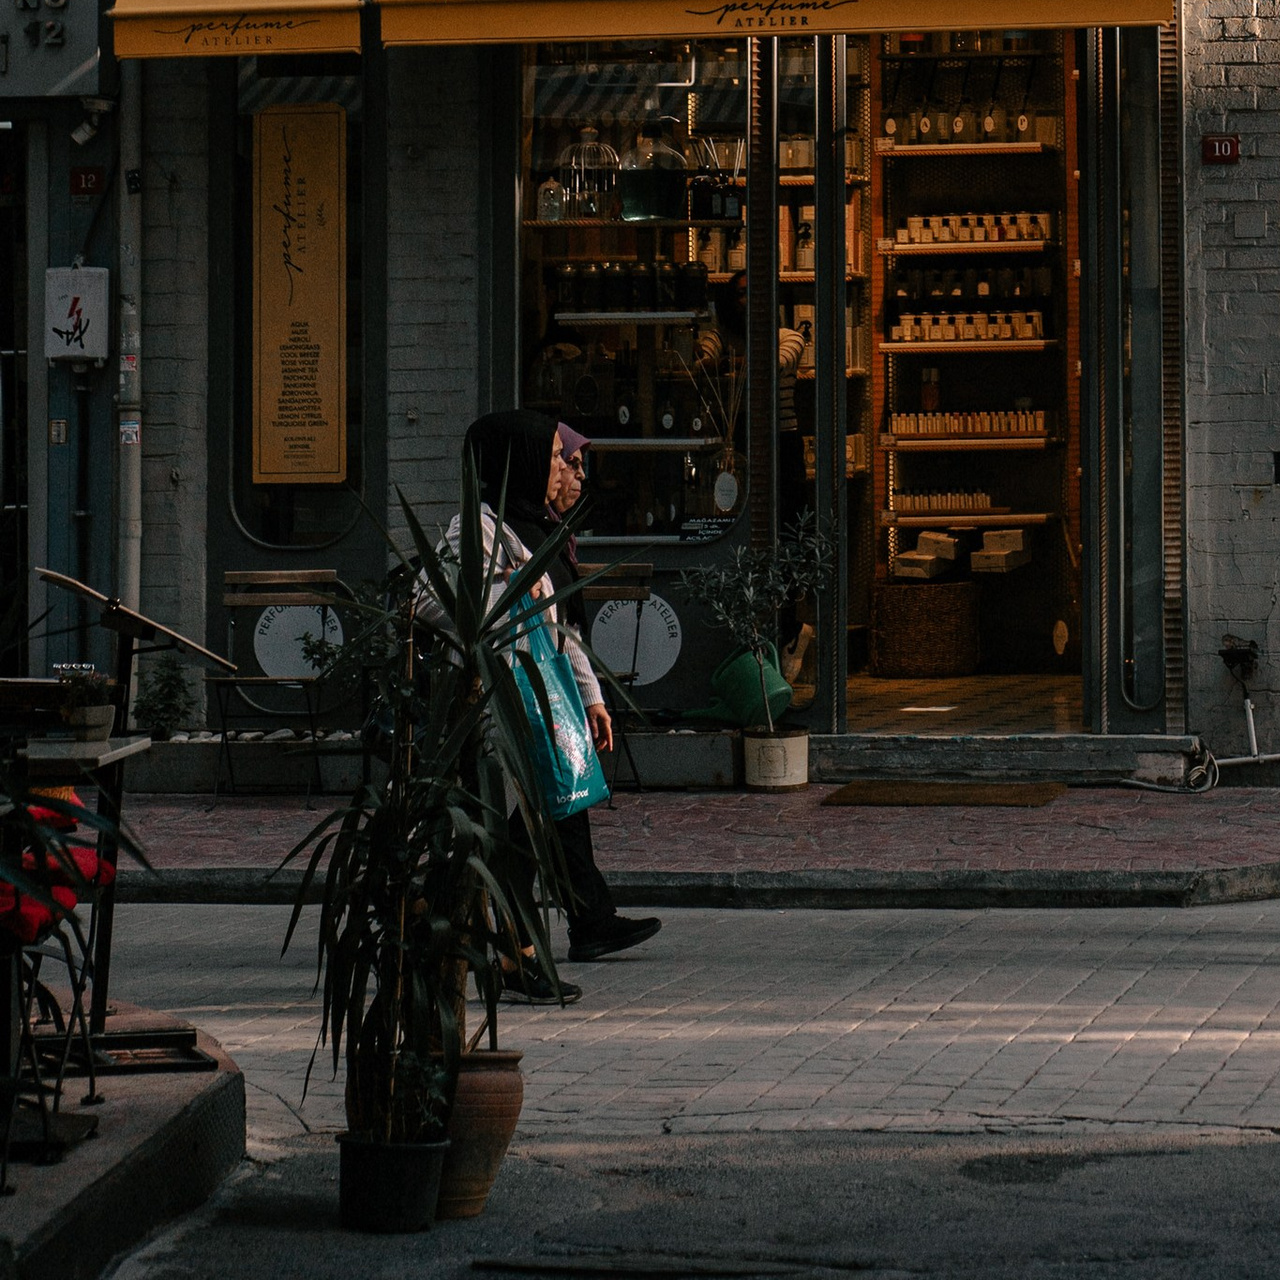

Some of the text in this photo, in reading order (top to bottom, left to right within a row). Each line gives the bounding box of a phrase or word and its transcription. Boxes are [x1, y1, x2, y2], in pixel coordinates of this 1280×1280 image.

[24, 20, 65, 47] 12
[154, 13, 321, 44] perfume
[735, 16, 809, 27] ATELIER
[201, 35, 273, 46] ATELIER
[1214, 141, 1231, 156] 10
[80, 173, 96, 188] 12
[273, 126, 303, 306] perfume
[297, 177, 306, 254] ATELIER
[599, 600, 678, 639] PERFU ATELIER
